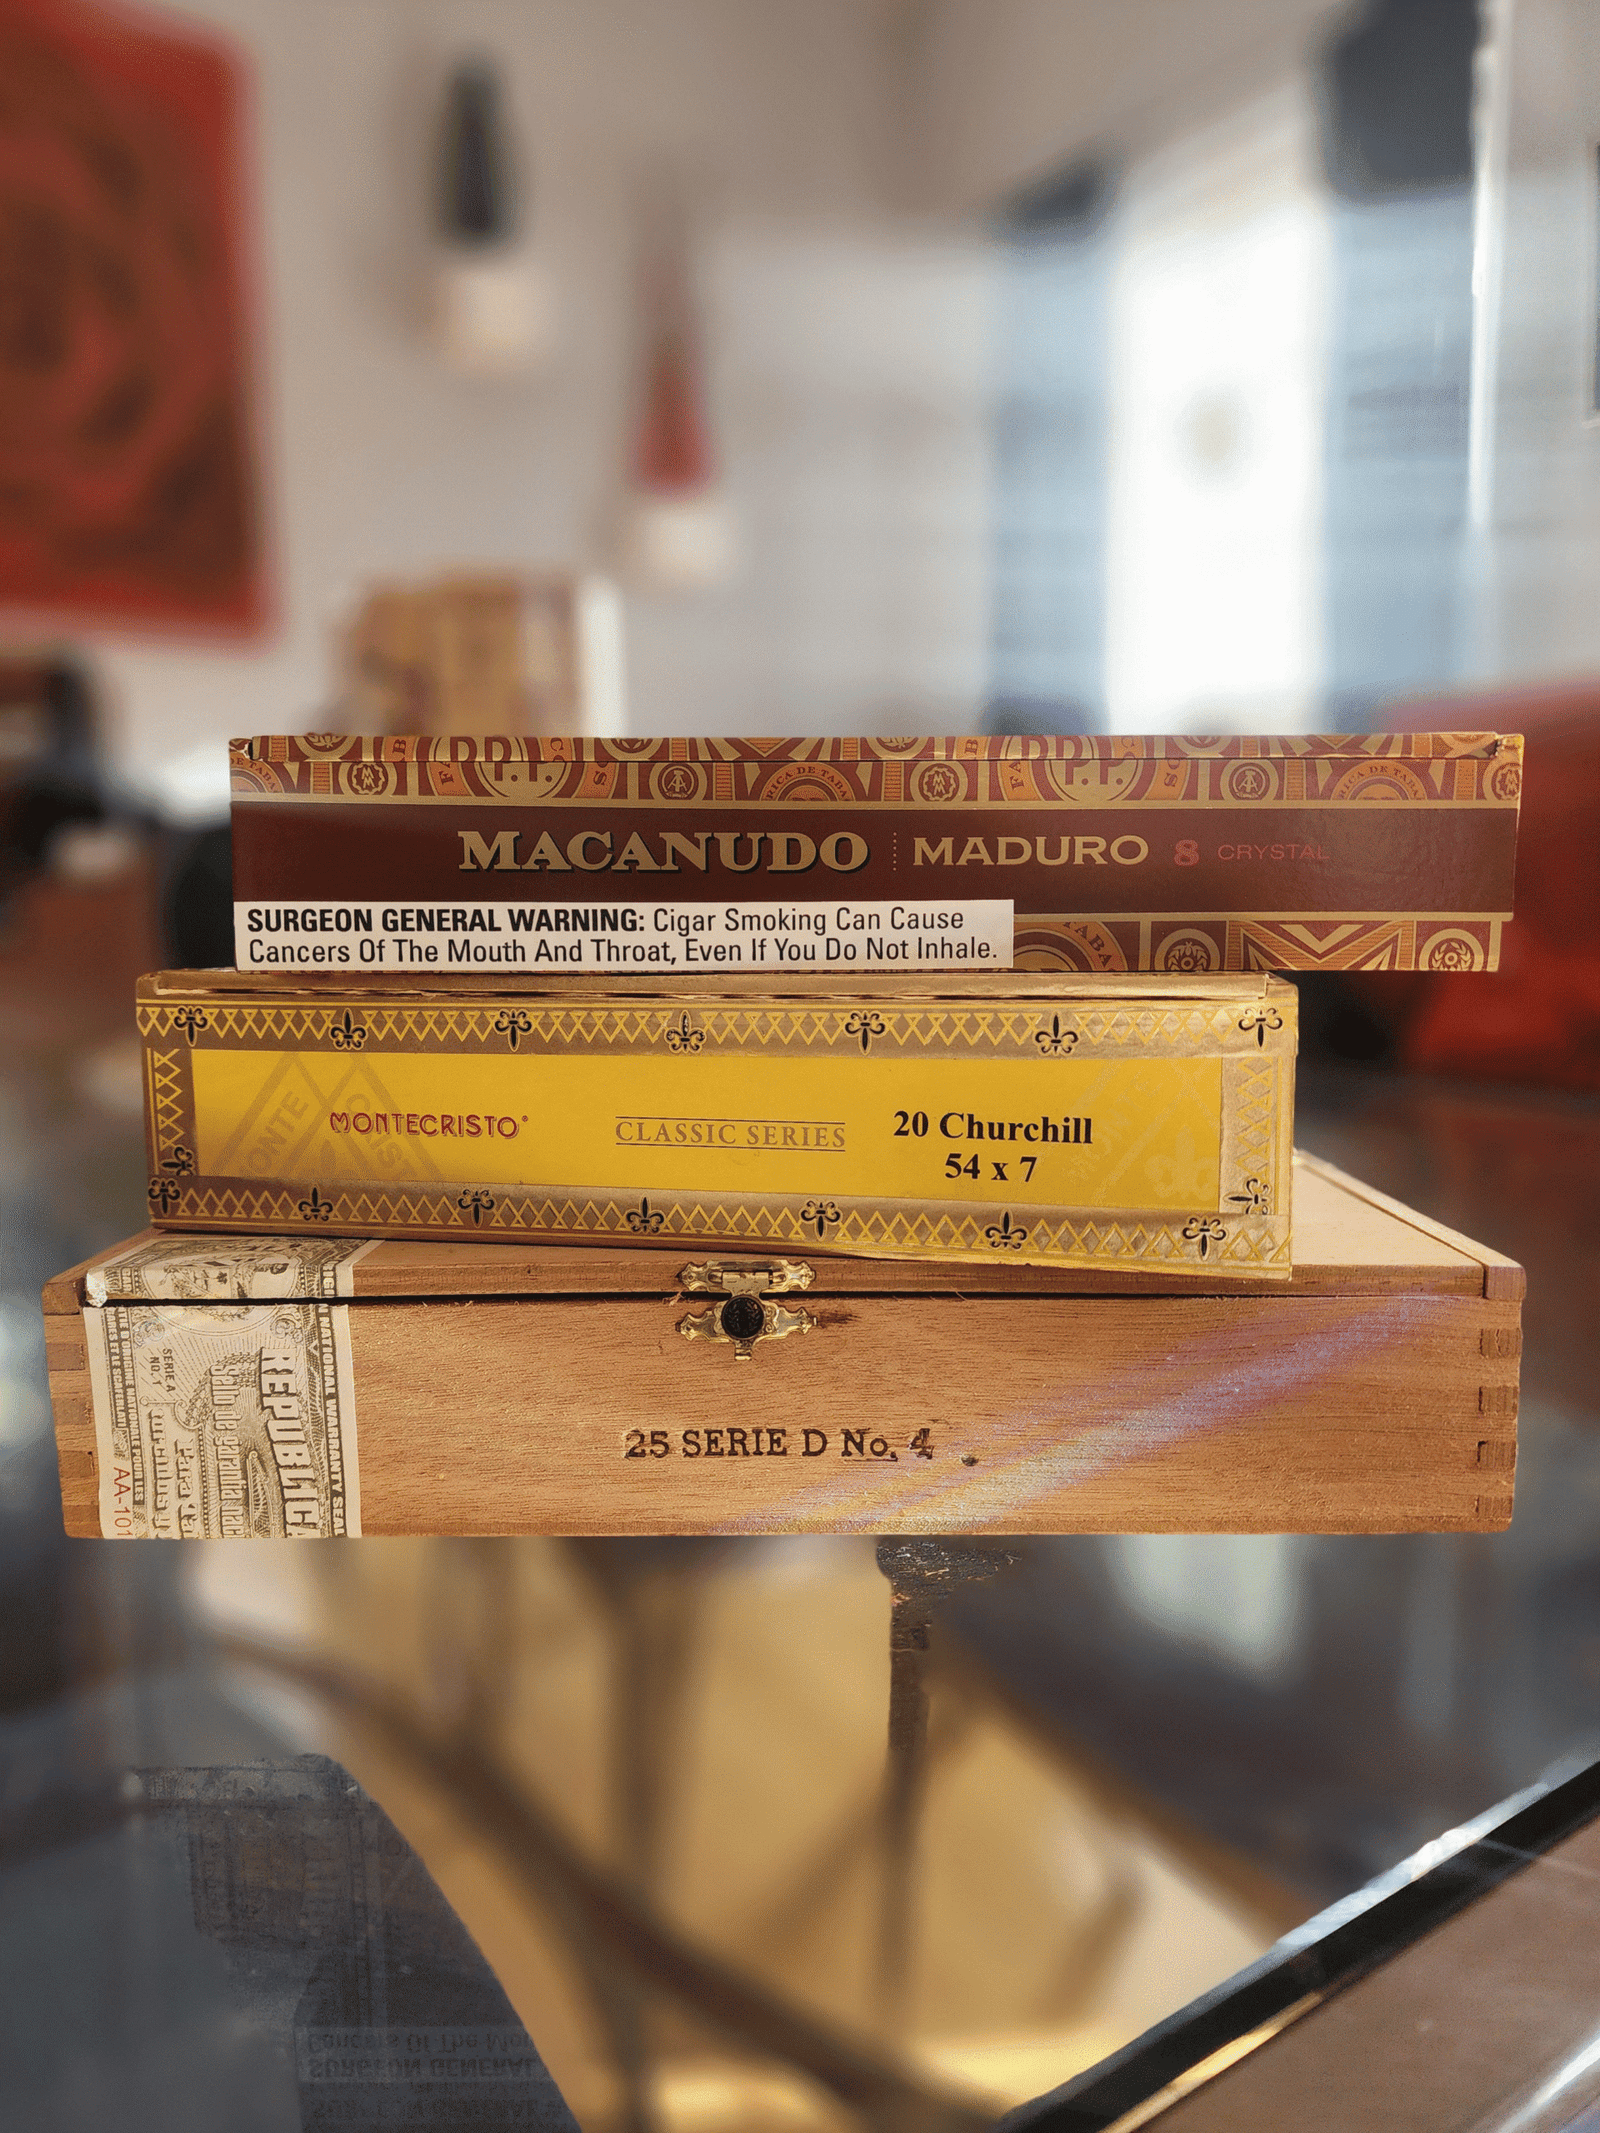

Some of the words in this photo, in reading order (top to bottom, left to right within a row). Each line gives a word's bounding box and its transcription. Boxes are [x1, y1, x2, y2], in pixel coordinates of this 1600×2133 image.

[458, 830, 871, 874] MACANUDO
[913, 835, 1148, 866] MADURO
[1174, 839, 1199, 867] 8
[1217, 844, 1330, 861] CRYSTAL
[248, 908, 373, 932] SURGEON
[382, 908, 502, 932] GENERAL
[508, 907, 645, 932] WARNING:
[653, 907, 716, 937] Cigar
[725, 907, 827, 936] Smoking
[836, 907, 881, 930] Can
[890, 906, 964, 930] Cause
[249, 938, 351, 963] Cancers
[359, 938, 386, 963] Of
[393, 938, 439, 963] The
[447, 938, 527, 963] Mouth
[534, 938, 583, 962] And
[590, 938, 677, 965] Throat,
[685, 938, 742, 962] Even
[752, 937, 768, 961] If
[774, 937, 816, 961] You
[825, 937, 857, 961] Do
[866, 936, 910, 960] Not
[916, 935, 998, 960] Inhale.
[615, 1120, 736, 1144] CLASSIC
[746, 1123, 846, 1149] SERIES
[893, 1110, 929, 1138] 20
[939, 1111, 1093, 1144] Churchill
[944, 1153, 981, 1180] 54
[990, 1161, 1009, 1181] x
[1019, 1155, 1038, 1183] 7
[162, 1348, 176, 1381] SERIE
[320, 1316, 336, 1396] NATIONAL
[165, 1384, 176, 1393] A
[209, 1363, 241, 1407] Sello
[126, 1387, 141, 1448] NATIONALE
[213, 1409, 243, 1431] de
[325, 1399, 343, 1493] WARRANTY
[624, 1429, 670, 1459] 25
[682, 1427, 787, 1458] SERIE
[801, 1428, 828, 1457] D
[840, 1427, 898, 1462] No.
[908, 1427, 934, 1460] 4
[132, 1449, 144, 1480] POUR
[174, 1438, 195, 1500] Para
[113, 1466, 134, 1538] AA-101
[133, 1480, 144, 1502] LES
[332, 1495, 345, 1537] SEAL
